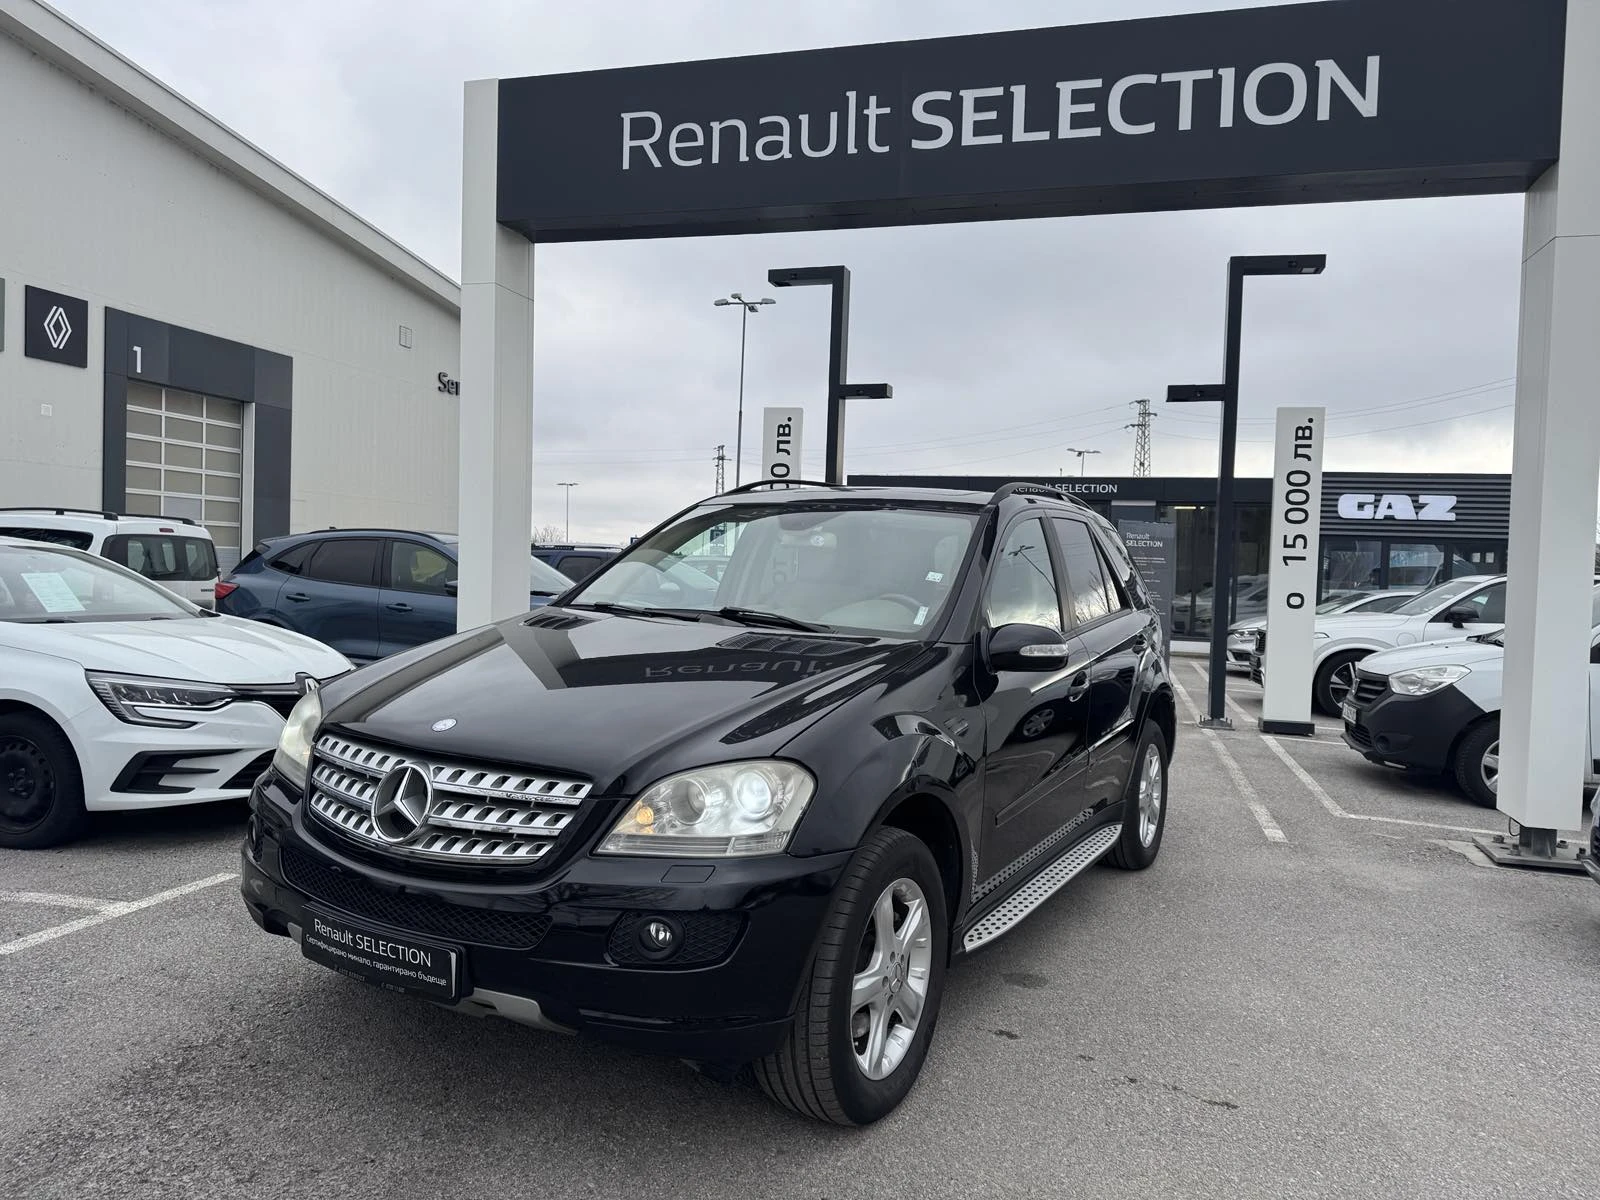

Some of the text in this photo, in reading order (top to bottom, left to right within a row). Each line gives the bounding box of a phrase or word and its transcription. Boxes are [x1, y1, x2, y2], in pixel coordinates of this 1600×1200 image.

[620, 54, 1381, 170] Renault SELECTION
[132, 345, 142, 374] 1
[1054, 483, 1118, 494] SELECTION
[1284, 469, 1311, 525] 000
[1337, 493, 1458, 521] GAZ
[1126, 540, 1163, 548] SELECTION
[1282, 533, 1308, 567] 15
[314, 918, 432, 968] Renault SELECTION
[372, 962, 417, 978] гарантирано
[417, 970, 447, 987] бъдеще
